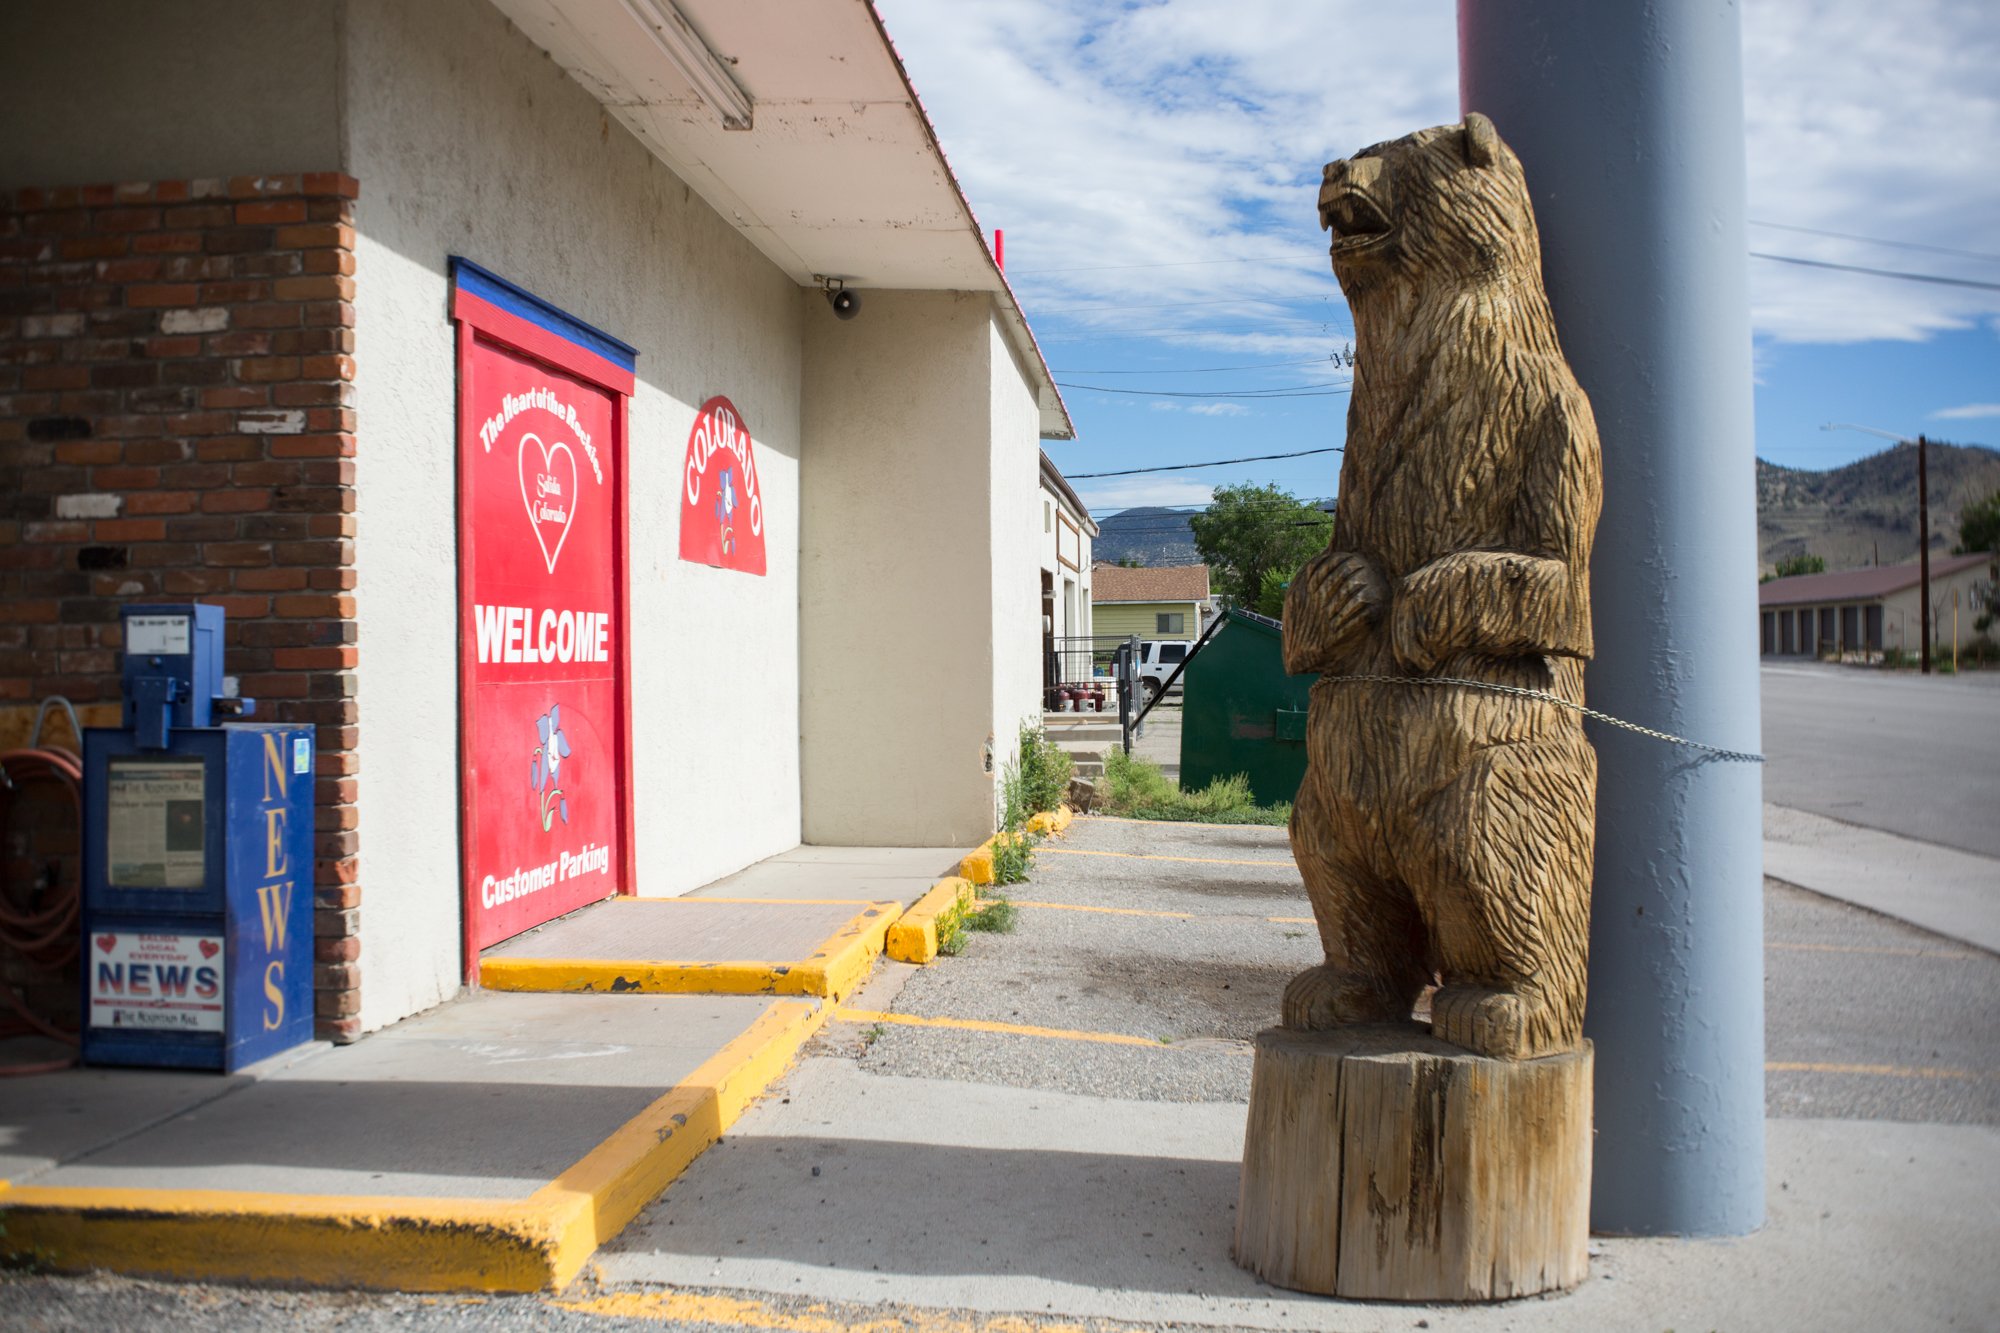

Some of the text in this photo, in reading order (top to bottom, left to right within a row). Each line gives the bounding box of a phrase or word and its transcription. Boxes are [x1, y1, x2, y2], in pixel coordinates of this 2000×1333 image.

[479, 386, 603, 485] The Heart of the Rockies
[536, 473, 561, 498] Salida
[686, 406, 761, 537] COLORADO
[533, 500, 567, 524] Colorado
[474, 604, 608, 664] WELCOME
[256, 731, 295, 1032] NEWS
[482, 842, 609, 910] Customer Parking
[129, 951, 189, 962] EVERYDAY
[140, 944, 177, 952] LOCAL
[98, 961, 219, 999] NEWS
